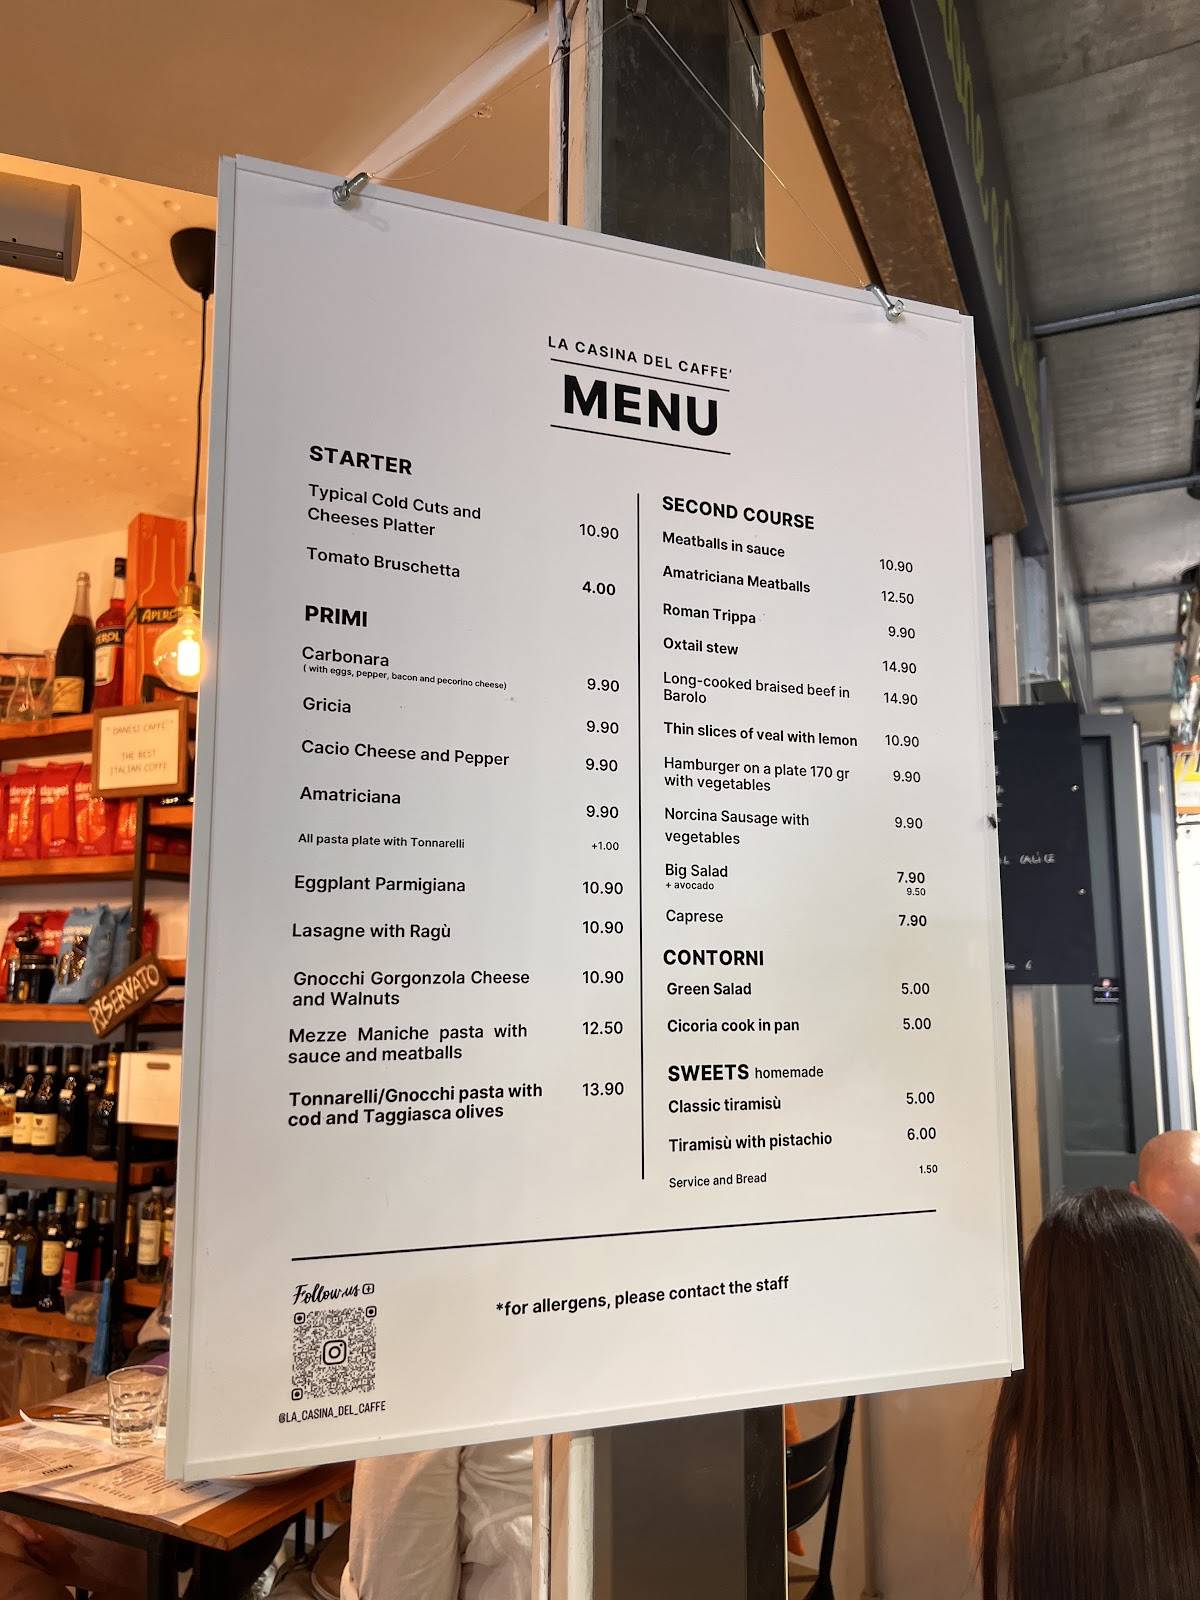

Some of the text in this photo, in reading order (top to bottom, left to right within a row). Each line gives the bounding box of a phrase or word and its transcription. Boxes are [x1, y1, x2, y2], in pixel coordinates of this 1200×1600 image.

[548, 336, 732, 379] LA CASINA DEL CAFFE'
[563, 374, 719, 436] MENU
[309, 445, 412, 475] STARTER
[308, 484, 480, 519] Typical Cold Cuts and
[308, 507, 435, 535] Cheeses Platter
[662, 496, 814, 530] SECOND COURSE
[580, 524, 619, 540] 10.90
[663, 531, 785, 557] Meatballs in sauce
[307, 547, 460, 578] Tomato Bruschetta
[663, 565, 810, 593] Amatriciana Meatballs
[582, 581, 615, 596] 4.00
[881, 591, 914, 604] 12.50
[305, 605, 367, 627] PRIMI
[663, 603, 756, 625] Roman Trippa
[663, 637, 738, 655] Oxtail stew
[302, 646, 389, 667] Carbonara
[309, 665, 328, 673] with
[330, 668, 354, 677] eggs,
[356, 670, 389, 680] pepper,
[392, 672, 418, 681] bacon
[437, 678, 473, 686] pecorino
[475, 680, 507, 690] cheese)
[587, 678, 619, 692] 9.90
[664, 672, 850, 698] Long-cooked braised beef in
[664, 689, 706, 703] Barolo
[884, 692, 918, 705] 14.90
[303, 697, 351, 713] Gricia
[664, 722, 857, 746] Thin slices of veal with lemon
[302, 740, 509, 767] Cacio Cheese and Pepper
[664, 756, 850, 782] Hamburger on a plate 170 gr
[664, 775, 771, 792] with vegetables
[300, 786, 400, 804] Amatriciana
[665, 807, 809, 827] Norcina Sausage with
[298, 833, 464, 848] All pasta plate with Tonnarelli
[592, 841, 619, 851] +1.00
[665, 832, 740, 845] vegetables
[666, 863, 728, 879] Big Salad
[897, 871, 925, 884] 7.90
[295, 875, 465, 895] Eggplant Parmigiana
[674, 881, 714, 890] avocado
[906, 887, 926, 896] 9.50
[666, 909, 723, 925] Caprese
[898, 914, 927, 927] 7.90
[292, 923, 450, 941] Lasagne with Ragù
[663, 949, 763, 966] CONTORNI
[294, 971, 530, 988] Gnocchi Gorgonzola Cheese
[667, 982, 751, 995] Green Salad
[902, 983, 930, 995] 5.00
[88, 964, 160, 1035] RISERVATO
[293, 991, 400, 1006] and Walnuts
[289, 1024, 527, 1043] Mezze Maniche pasta with
[583, 1021, 623, 1035] 12.50
[667, 1018, 799, 1034] Cicoria cook in pan
[288, 1045, 462, 1064] sauce and meatballs
[668, 1064, 823, 1082] SWEETS homemade
[289, 1083, 542, 1106] Tonnarelli/Gnocchi pasta with
[582, 1082, 624, 1096] 13.90
[906, 1091, 935, 1104] 5.00
[669, 1096, 781, 1113] Classic tiramisù
[288, 1104, 503, 1127] cod and Taggiasca olives
[669, 1132, 832, 1152] Tiramisù with pistachio
[907, 1127, 936, 1140] 6.00
[919, 1164, 938, 1174] 1.50
[669, 1172, 767, 1188] Service and Bread
[341, 1284, 360, 1298] us
[533, 1296, 610, 1313] allergens,
[615, 1291, 665, 1309] please
[669, 1282, 725, 1300] contact
[729, 1280, 752, 1294] the
[756, 1275, 789, 1292] staff
[278, 1400, 386, 1423] @LA_CASINA_DEL_CAFFE
